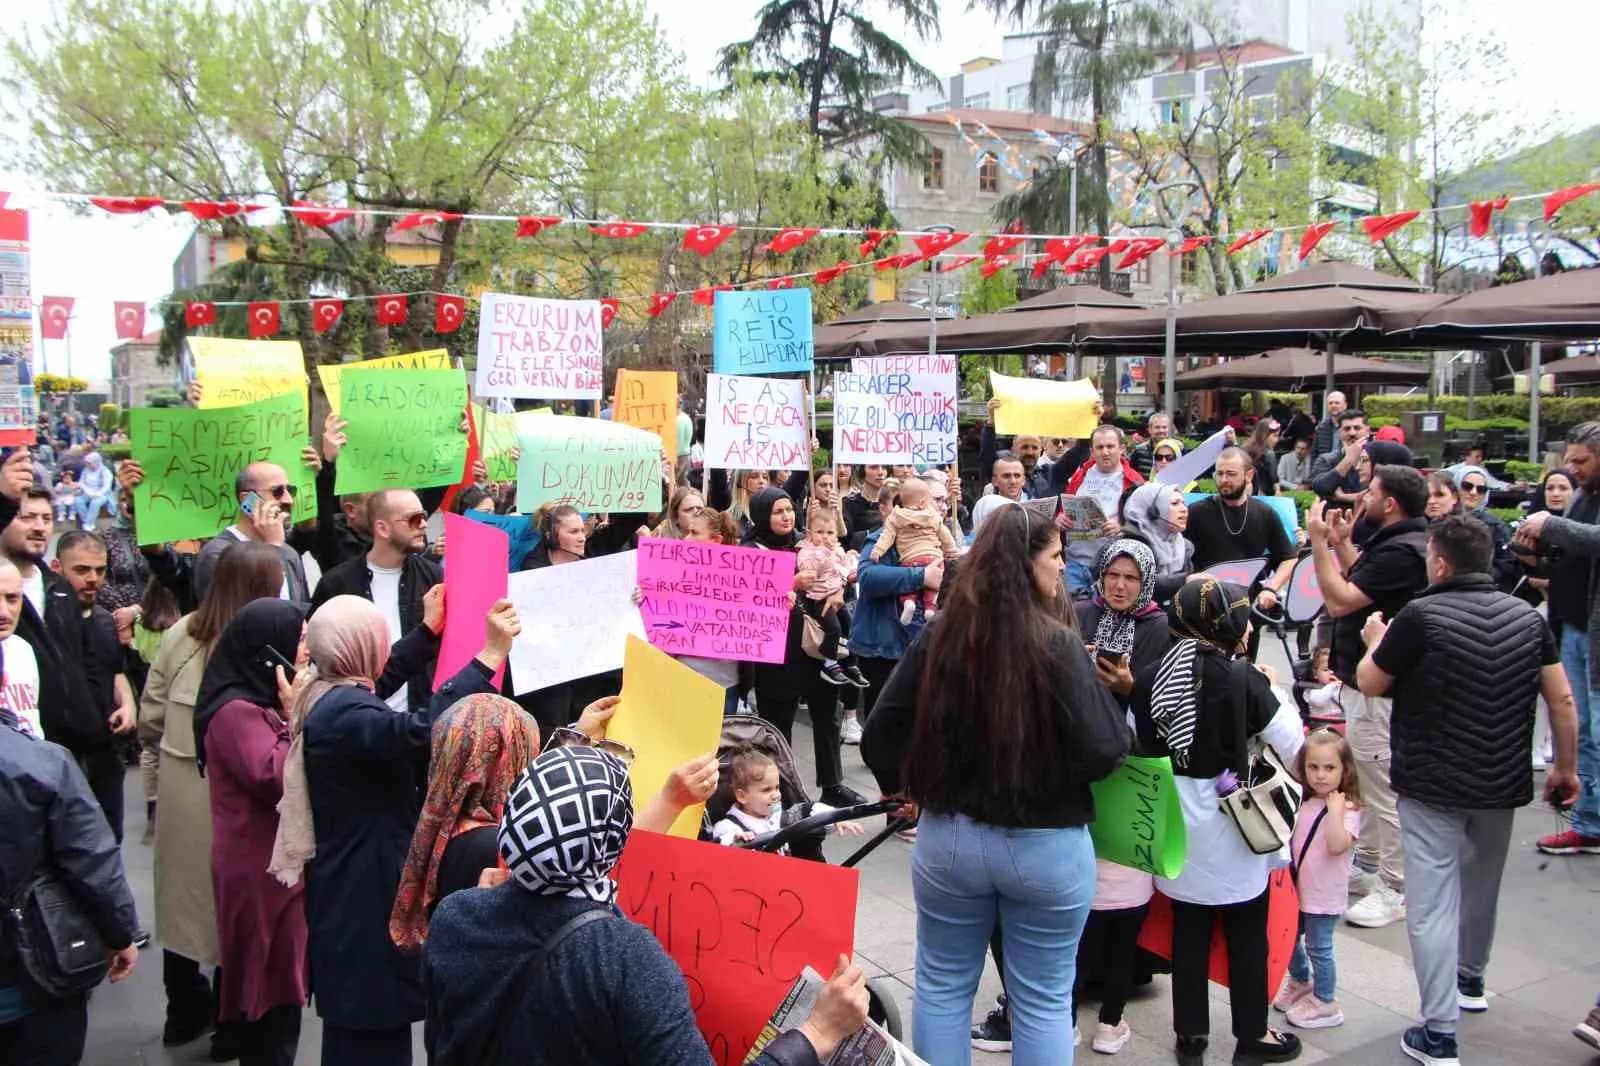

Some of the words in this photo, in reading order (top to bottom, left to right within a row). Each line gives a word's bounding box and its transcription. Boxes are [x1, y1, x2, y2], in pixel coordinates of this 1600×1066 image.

[741, 295, 789, 313] ALO
[494, 302, 596, 334] ERZURUM
[728, 314, 795, 344] REİS
[493, 354, 516, 370] EL
[520, 355, 555, 371] ELE
[722, 403, 750, 425] NE
[866, 405, 887, 429] BU
[911, 437, 957, 464] REİS
[542, 458, 661, 490] DOKUNMA
[718, 551, 776, 575] SUYU
